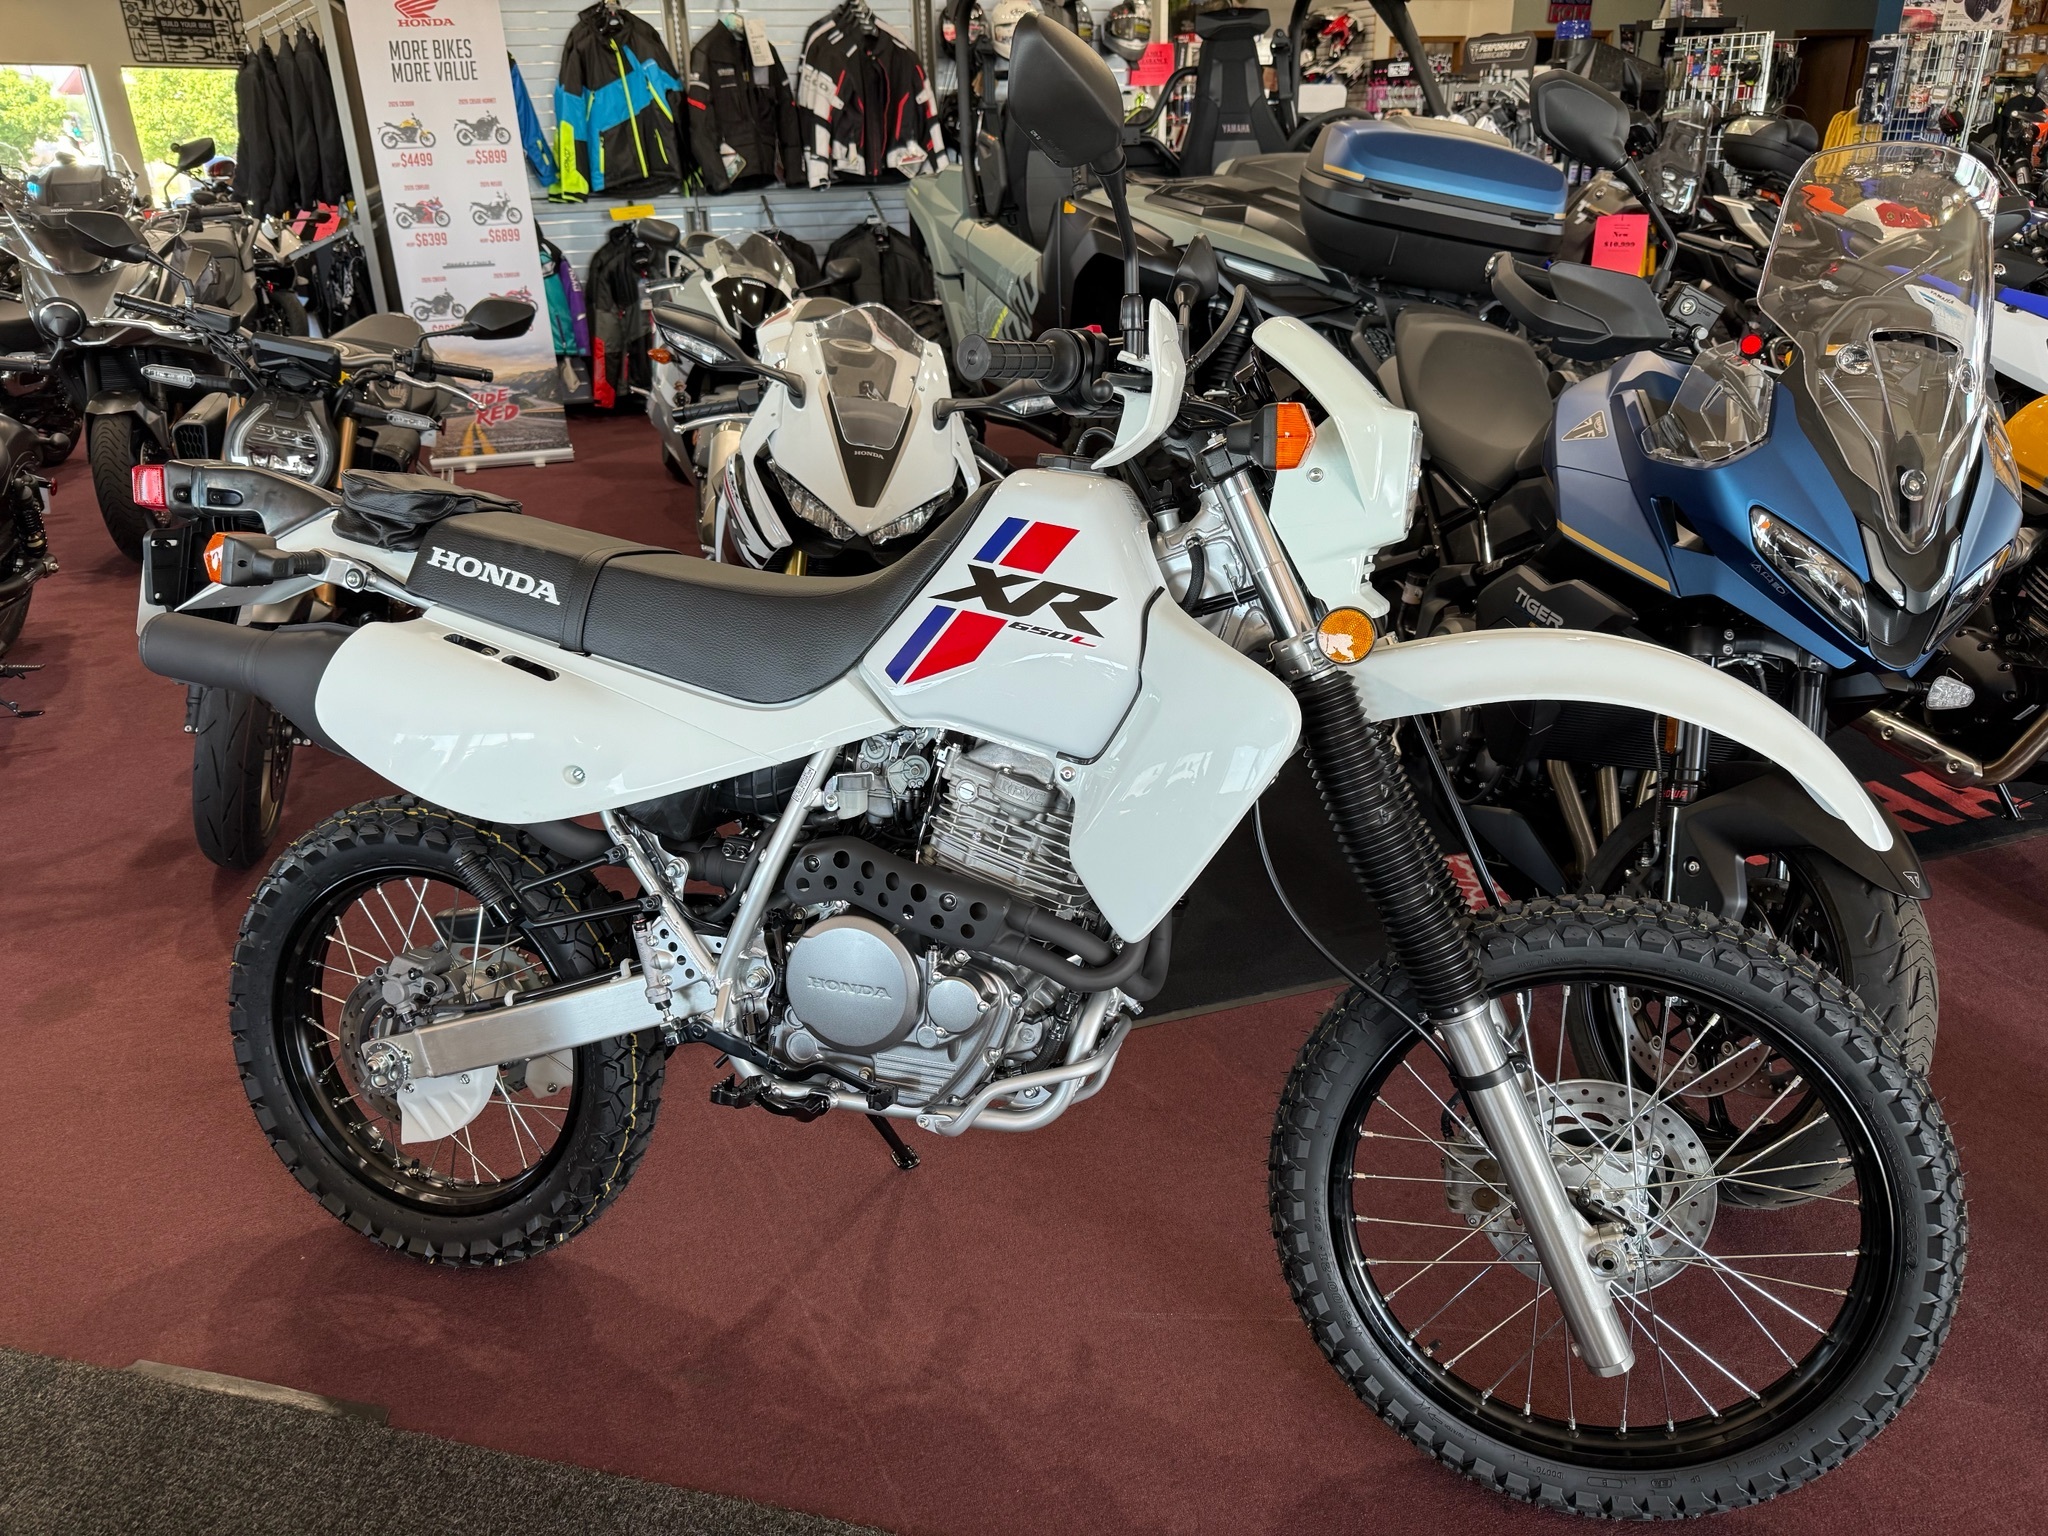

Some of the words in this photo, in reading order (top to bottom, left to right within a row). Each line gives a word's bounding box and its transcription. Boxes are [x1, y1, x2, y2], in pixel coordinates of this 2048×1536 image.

[397, 18, 455, 27] HONDA
[389, 40, 428, 61] MORE
[433, 39, 473, 59] BIKES
[1478, 40, 1528, 53] PERFORMANCE
[391, 62, 432, 83] MORE
[436, 61, 479, 81] VALUE
[1222, 124, 1250, 133] YAMAHA
[401, 152, 433, 168] $4499
[475, 149, 508, 165] $5899
[415, 232, 448, 248] $6399
[489, 229, 521, 244] $6899
[1930, 290, 1954, 304] YAMAHA
[475, 404, 520, 427] RED
[854, 450, 884, 460] HONDA
[427, 546, 560, 605] HONDA
[929, 564, 1118, 639] XR
[1515, 586, 1564, 628] TIGER
[1008, 621, 1098, 648] 650L
[1001, 778, 1046, 806] RFVC
[806, 975, 893, 1001] HONDA
[1319, 1252, 1350, 1321] 3.00-21
